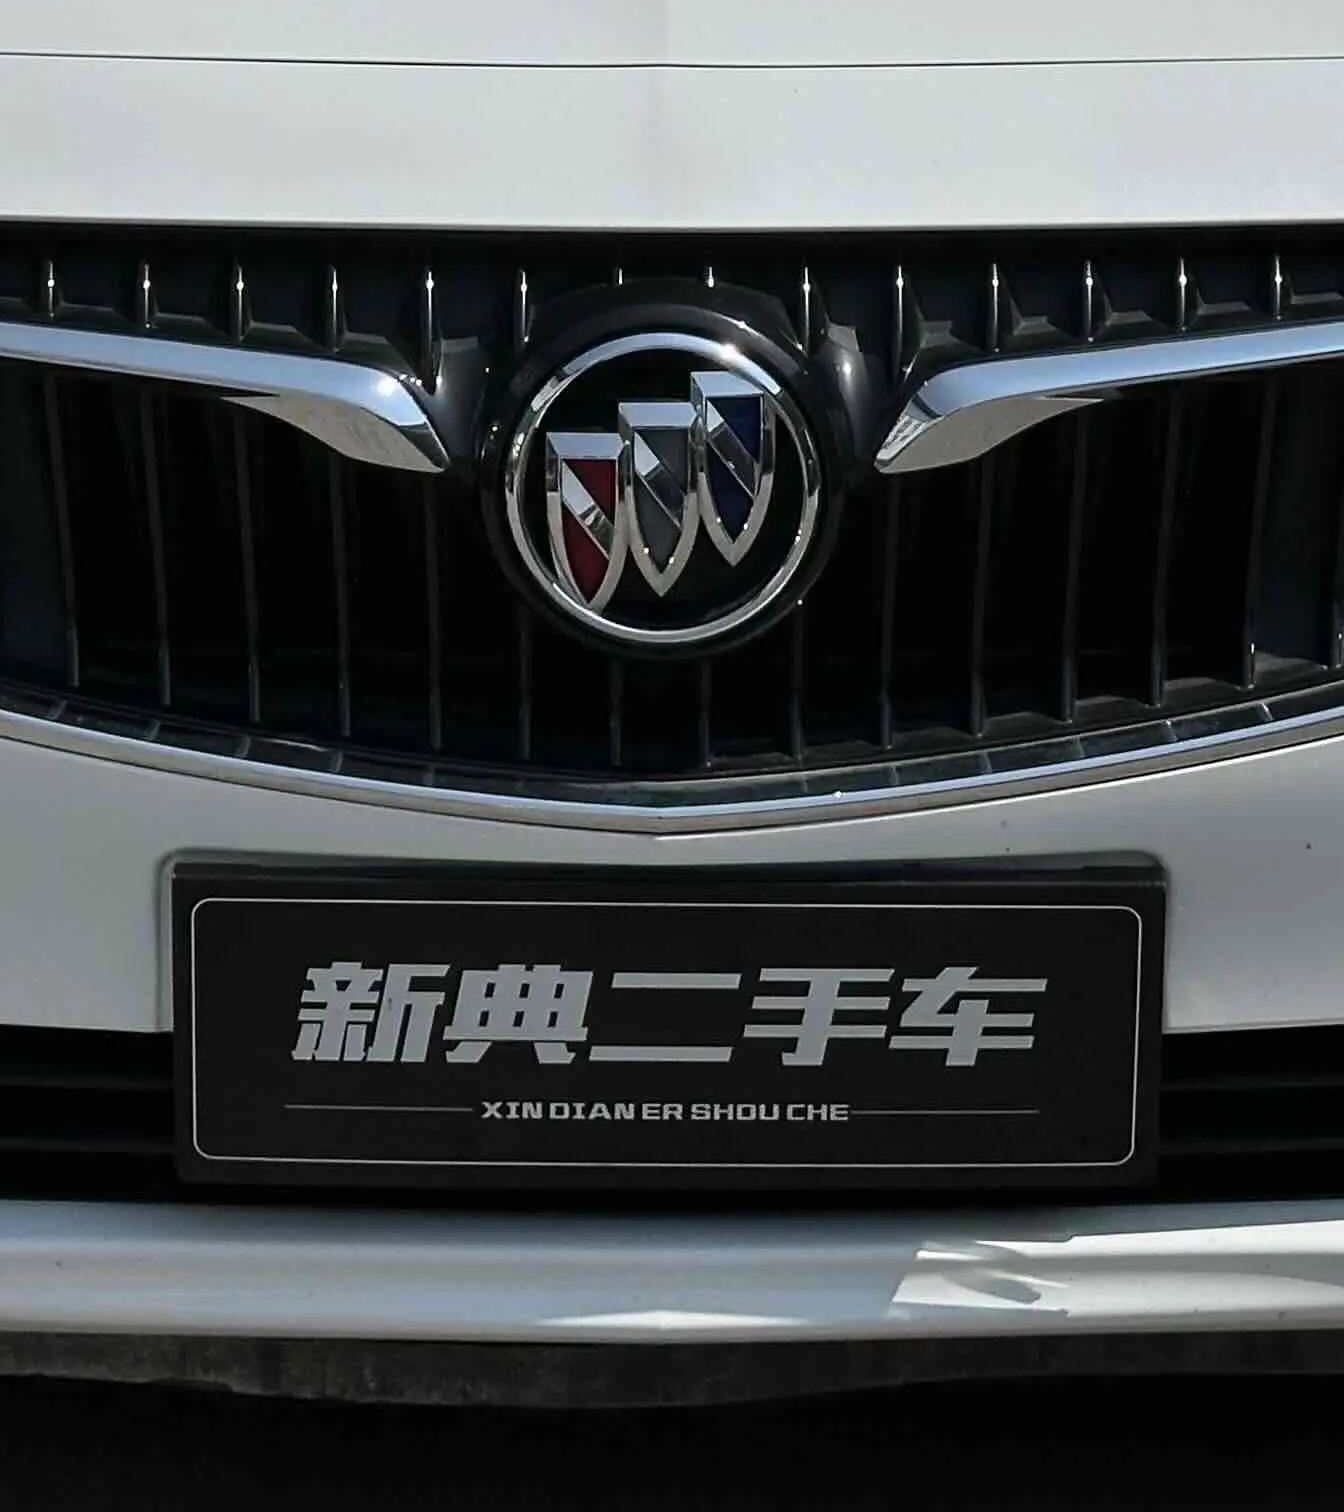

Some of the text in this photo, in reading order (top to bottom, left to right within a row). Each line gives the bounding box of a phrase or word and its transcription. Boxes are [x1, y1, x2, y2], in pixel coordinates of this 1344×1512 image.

[290, 960, 1048, 1067] 新典二手车
[481, 1101, 850, 1121] XIN DIAN ER SHOU CHE
